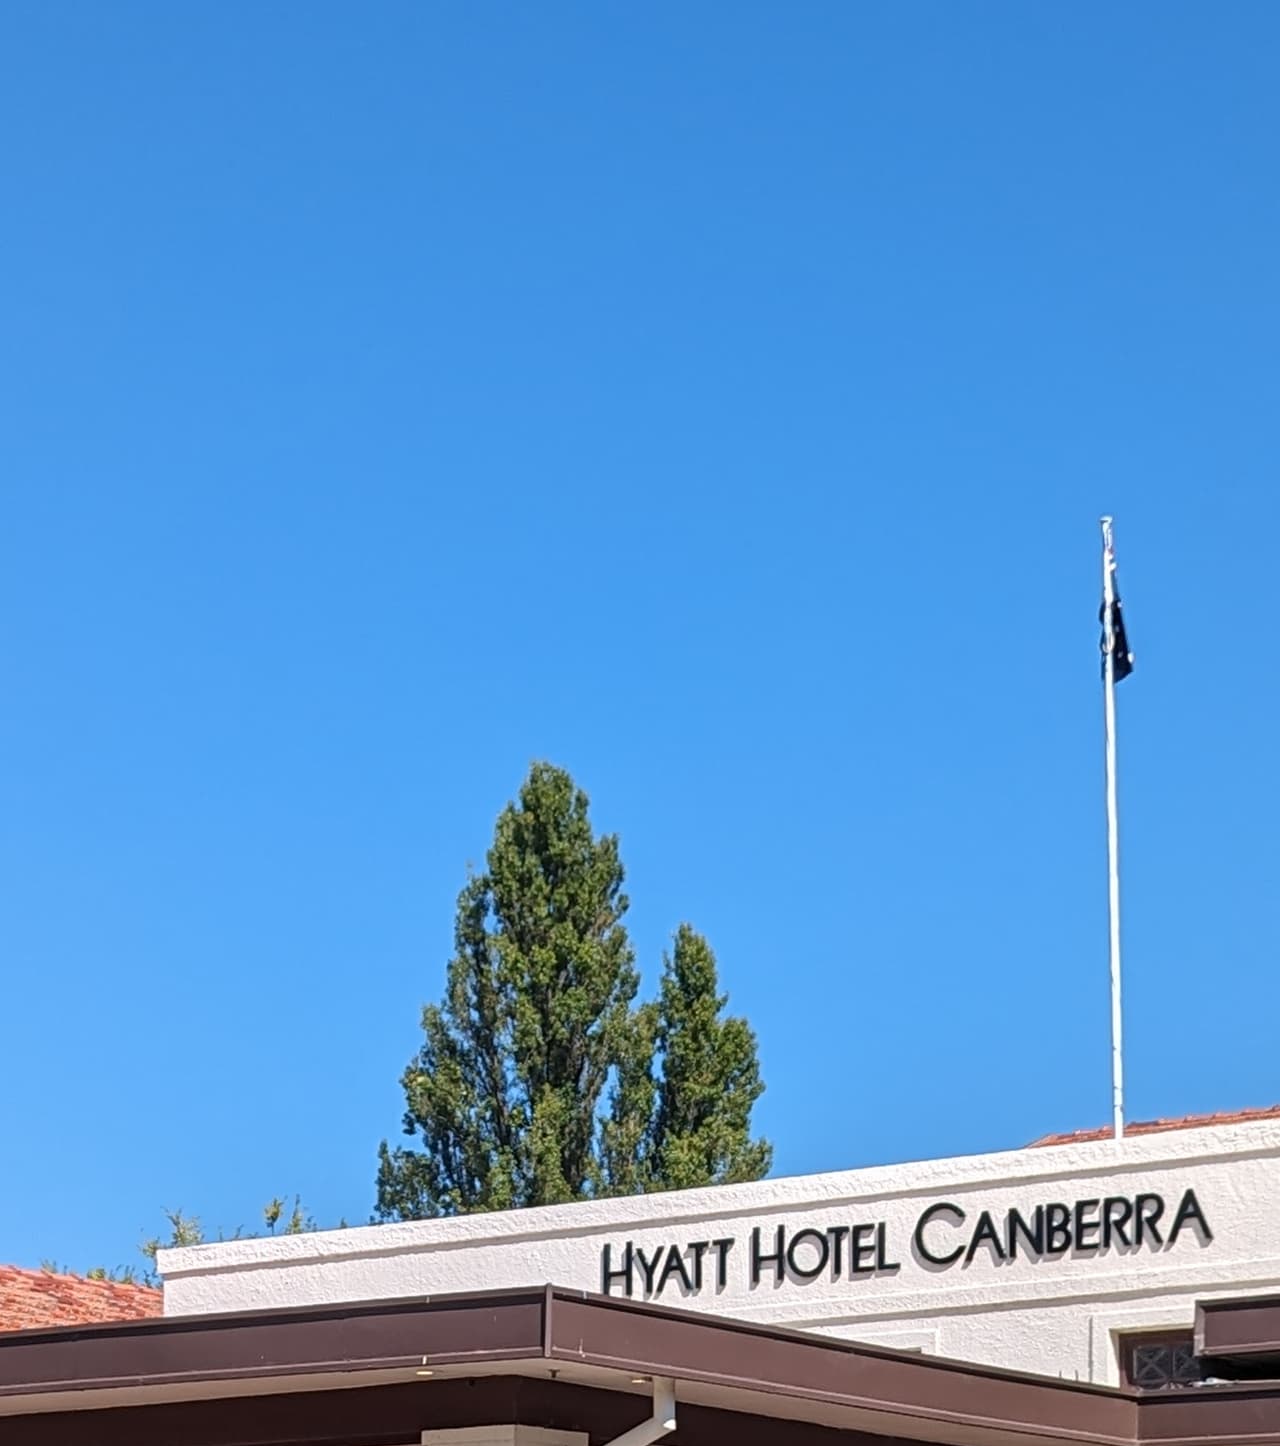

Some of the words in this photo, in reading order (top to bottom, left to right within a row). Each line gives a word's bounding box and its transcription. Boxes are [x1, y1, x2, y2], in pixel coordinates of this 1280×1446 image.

[603, 1238, 735, 1296] HYATT
[752, 1223, 901, 1284] HOTEL
[914, 1189, 1213, 1266] CANBERRA
